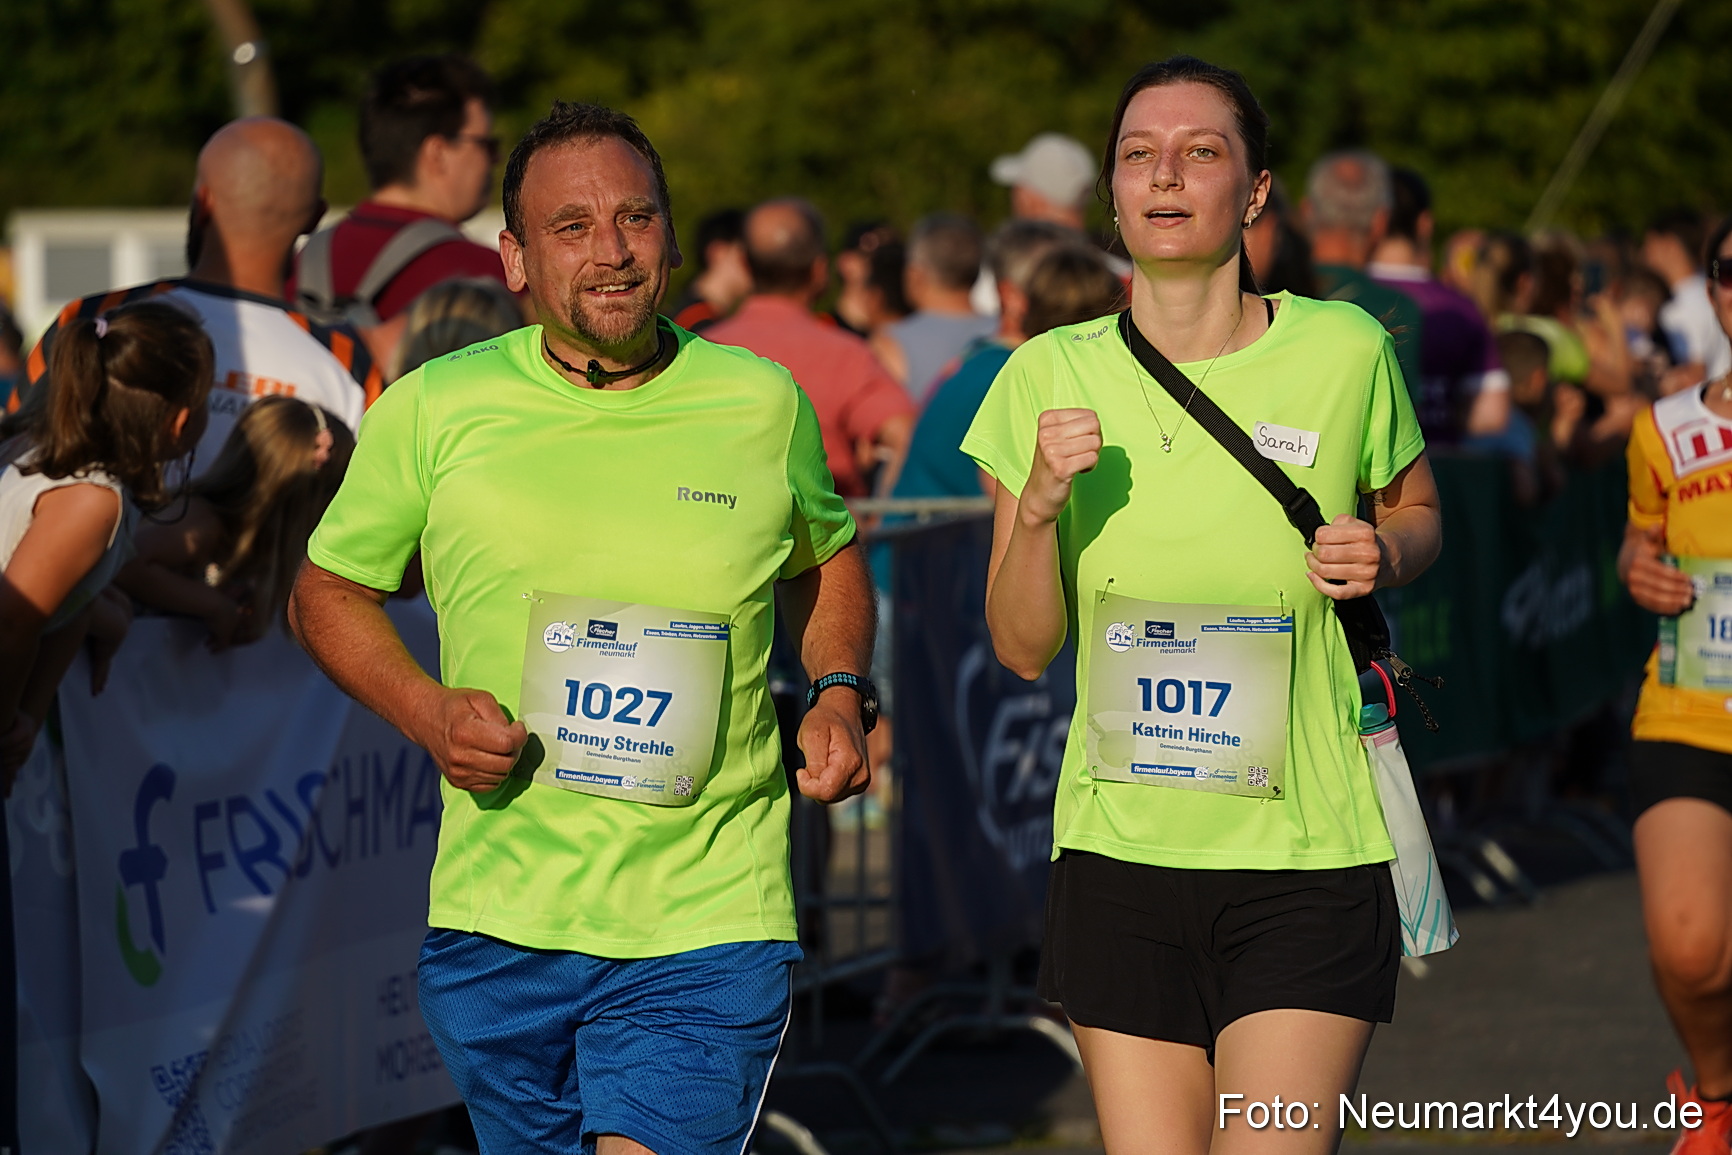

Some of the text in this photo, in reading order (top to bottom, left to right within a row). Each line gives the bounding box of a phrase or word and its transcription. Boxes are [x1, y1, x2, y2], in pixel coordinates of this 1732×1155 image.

[1085, 325, 1109, 341] JAKO
[466, 344, 499, 357] JAKO
[1257, 425, 1309, 456] Sarah
[677, 486, 738, 510] Ronny
[576, 637, 639, 652] Firmenlauf
[1136, 638, 1197, 648] Firmenlauf
[599, 650, 636, 658] neumarkt
[565, 678, 673, 728] 1027
[1137, 677, 1232, 718] 1017
[556, 726, 675, 757] Ronny Strehle
[1132, 722, 1241, 747] Katrin Hirche
[1159, 743, 1212, 755] Gemeinde Burgthann
[586, 750, 641, 764] Gemeinde Burgthann
[558, 771, 619, 785] firmenlauf.bayern
[1134, 765, 1193, 777] firmenlauf.bayern
